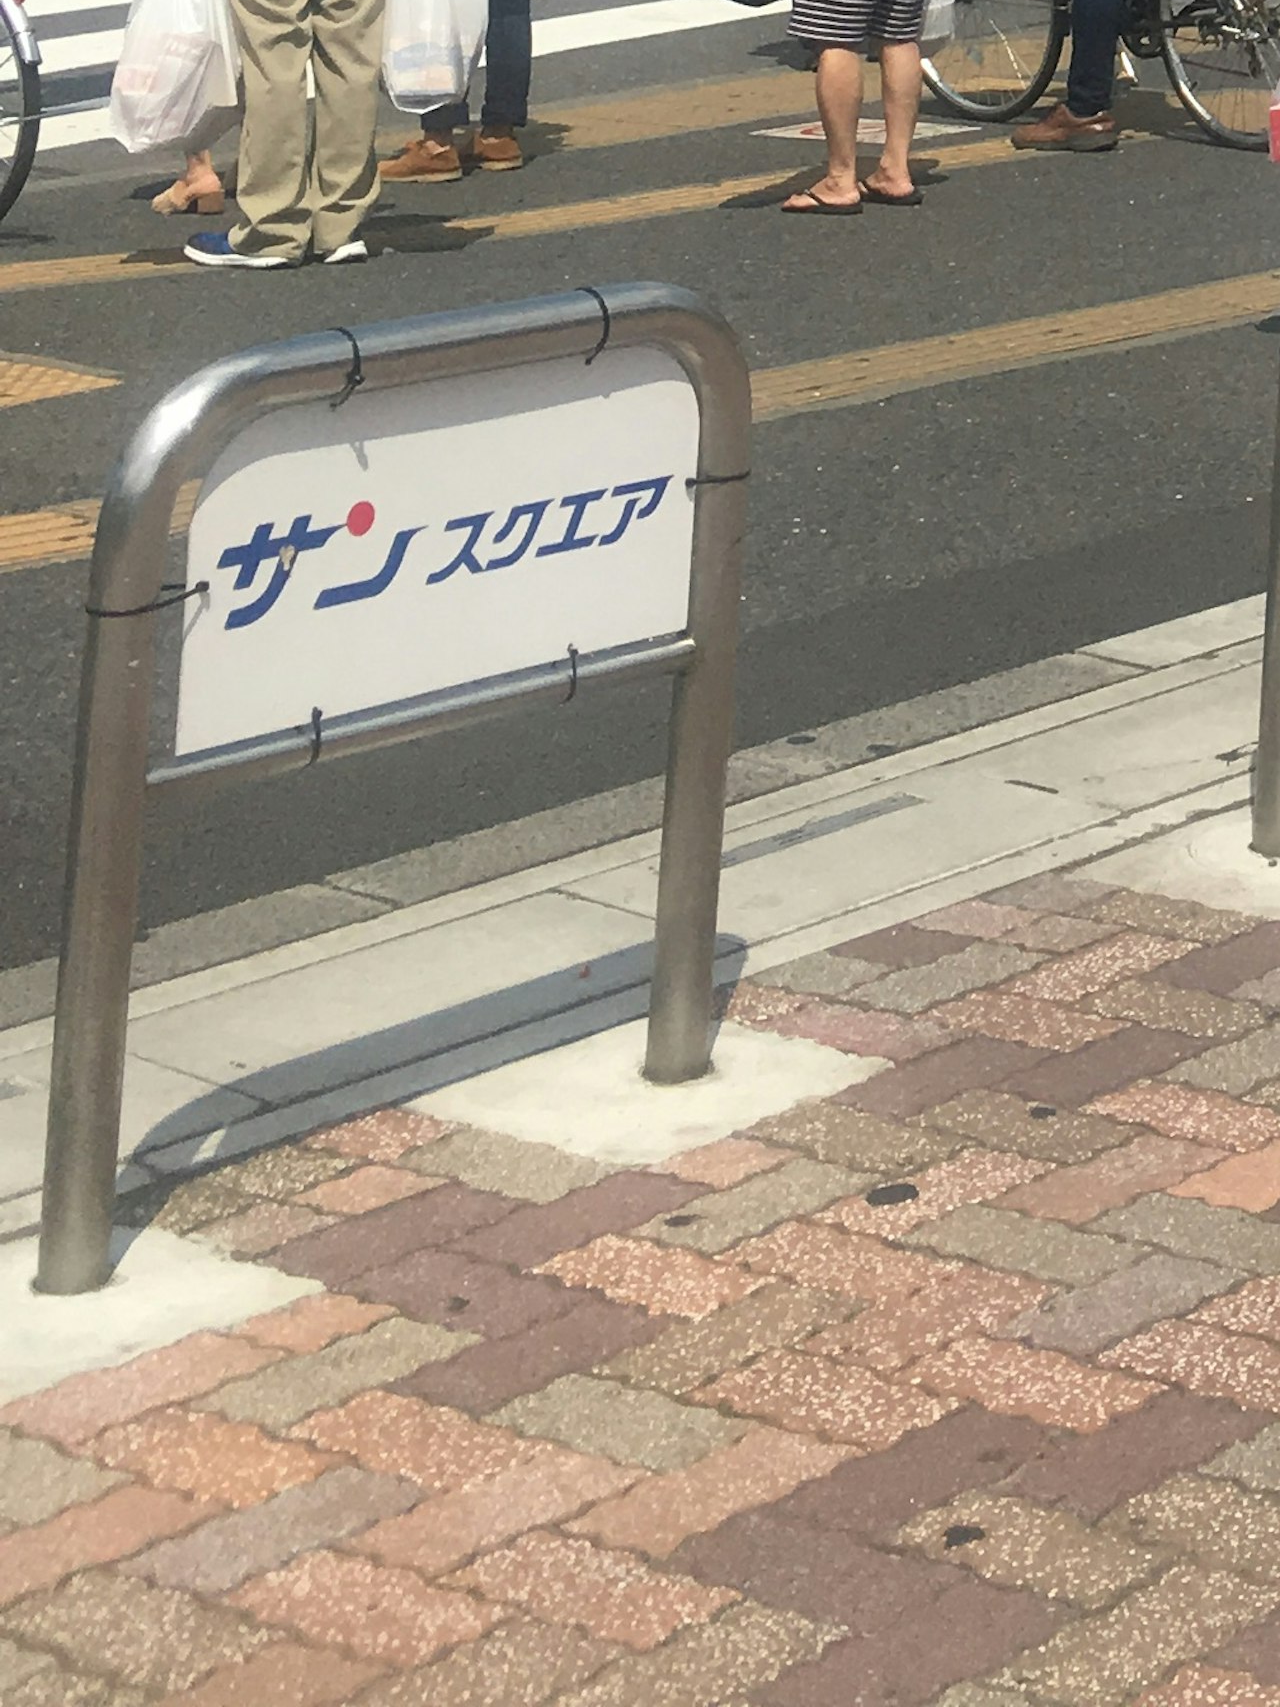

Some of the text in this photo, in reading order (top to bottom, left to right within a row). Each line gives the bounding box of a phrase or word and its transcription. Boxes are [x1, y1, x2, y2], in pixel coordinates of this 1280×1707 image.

[216, 474, 674, 631] サンスクエア
